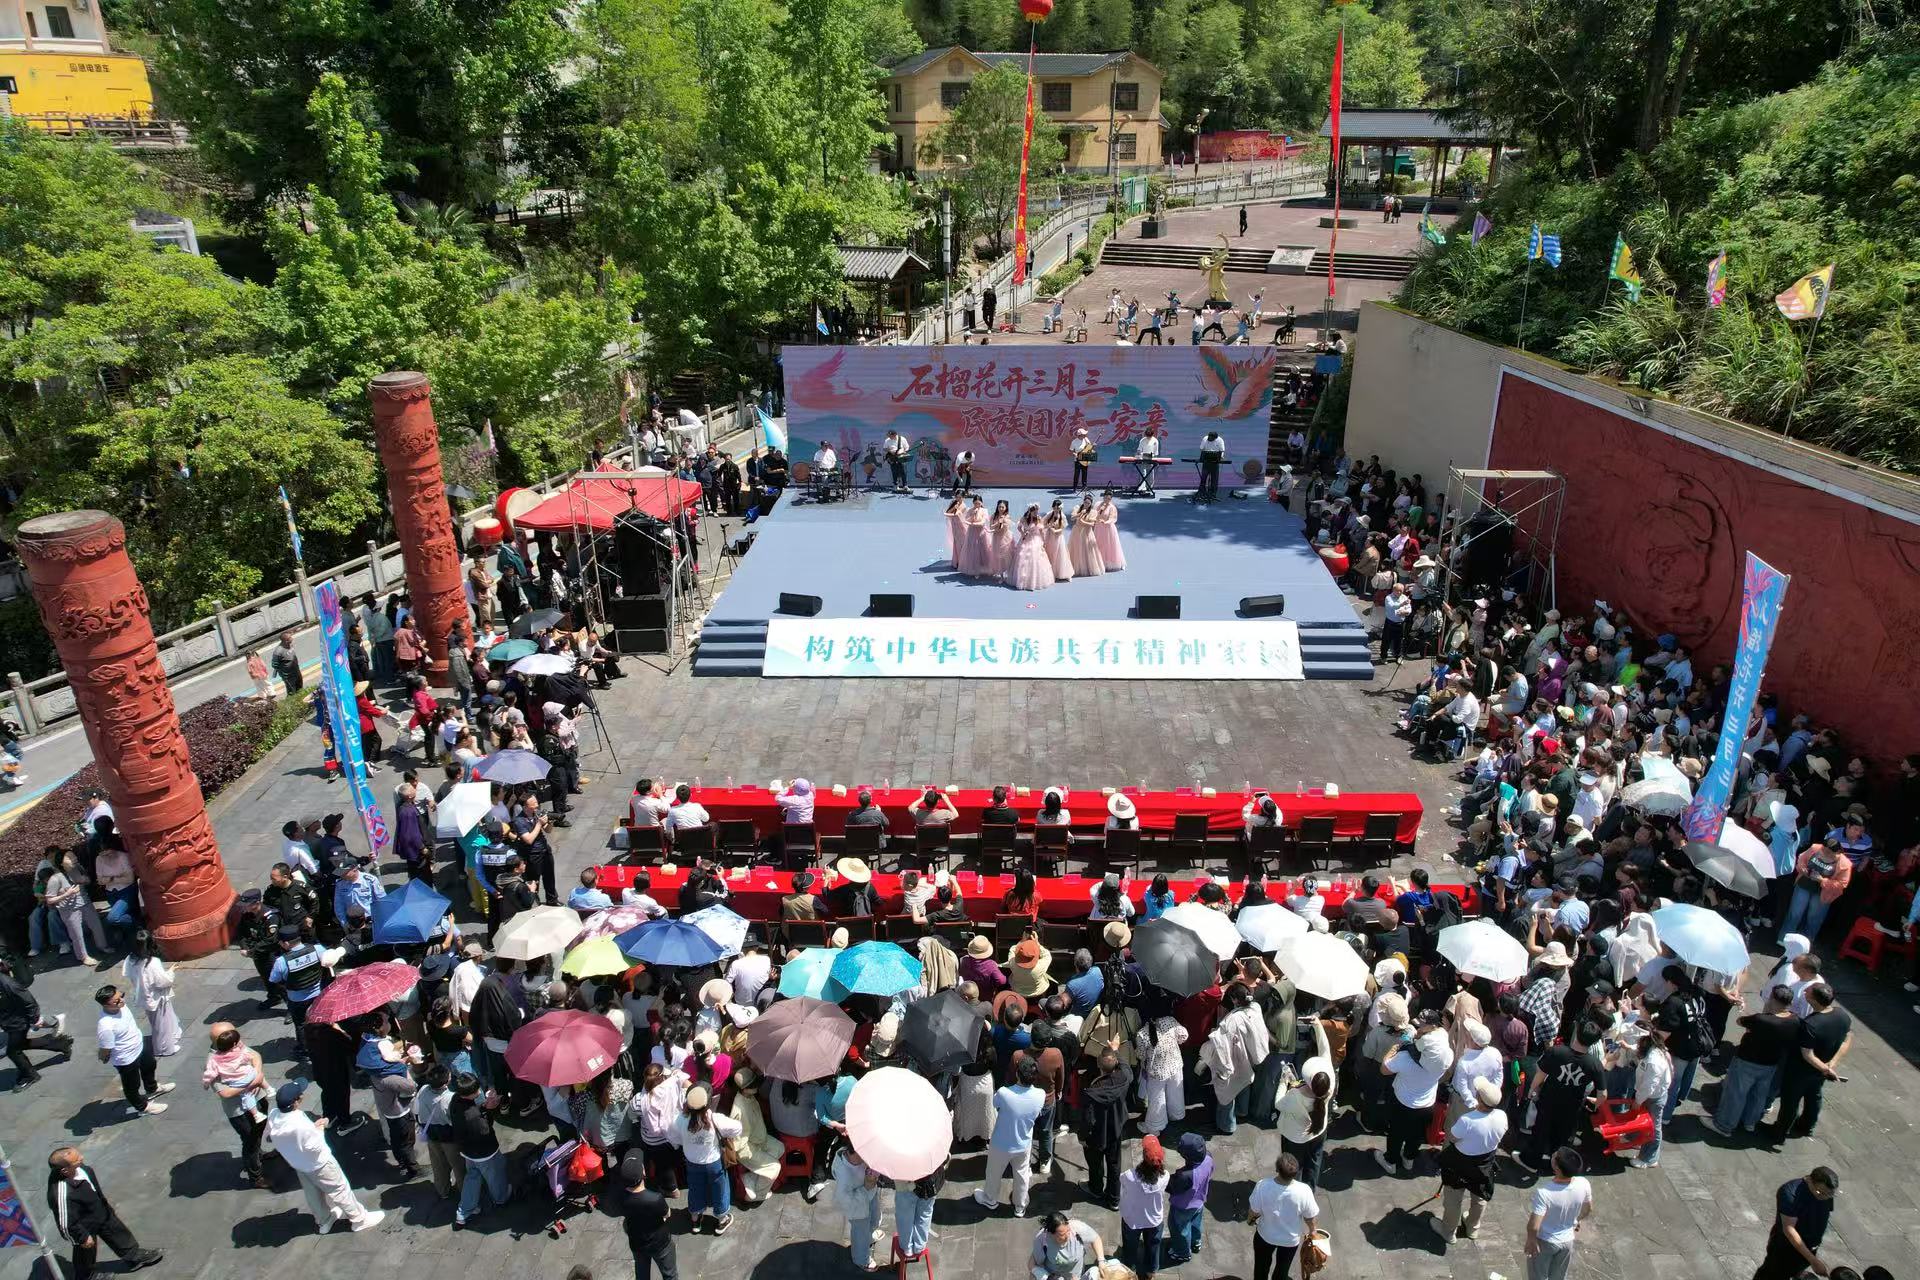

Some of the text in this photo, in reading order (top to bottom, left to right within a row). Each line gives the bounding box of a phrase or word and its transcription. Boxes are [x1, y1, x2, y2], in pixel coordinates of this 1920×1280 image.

[892, 361, 1118, 402] 石榴花开三月三
[961, 402, 1169, 447] 民族团结一家亲
[1557, 1063, 1585, 1086] NY
